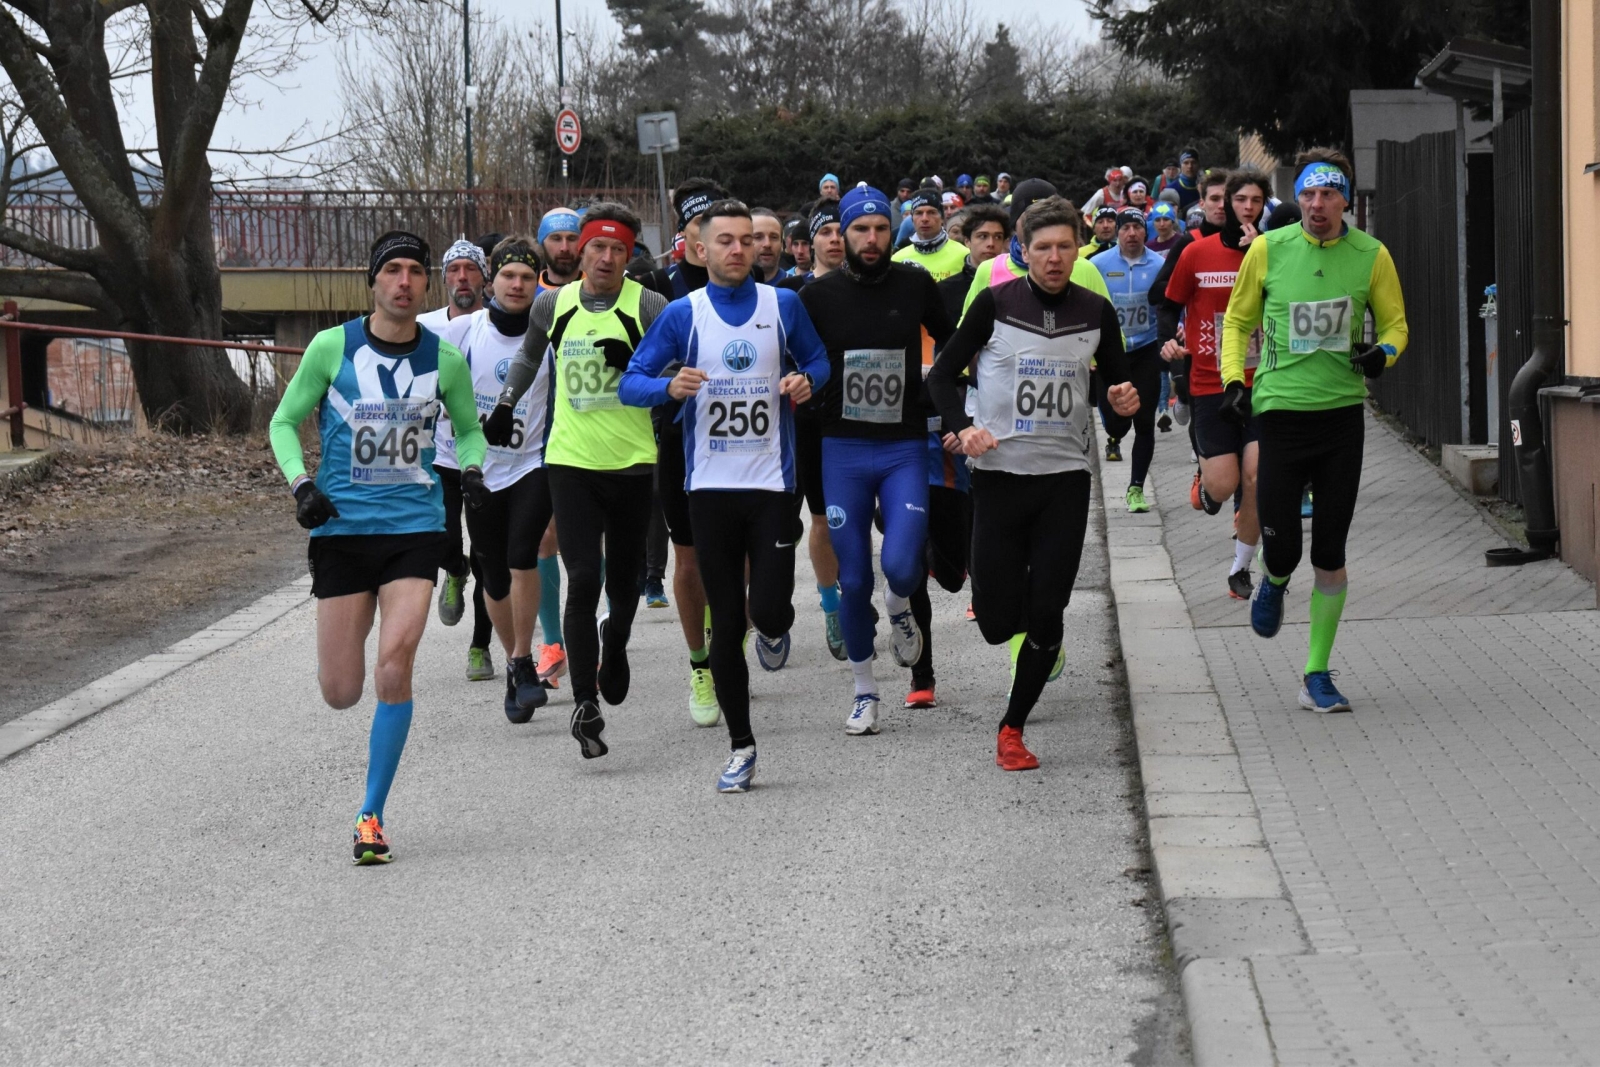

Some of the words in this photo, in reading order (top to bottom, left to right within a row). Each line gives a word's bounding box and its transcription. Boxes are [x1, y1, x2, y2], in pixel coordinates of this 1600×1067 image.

[1303, 172, 1346, 188] eleven
[1115, 305, 1148, 327] 676
[1293, 300, 1348, 337] 657
[564, 338, 586, 348] ZIMNÍ
[562, 347, 598, 357] BĚŽECKÁ
[884, 361, 903, 369] LIGA
[1019, 357, 1046, 367] ZIMNÍ
[1018, 366, 1056, 377] BĚŽECKÁ
[1059, 369, 1076, 378] LIGA
[564, 360, 621, 396] 632
[707, 376, 734, 387] ZIMNÍ
[707, 386, 747, 396] BĚŽECKÁ
[750, 385, 770, 395] LIGA
[846, 371, 903, 407] 669
[474, 392, 497, 403] ZIMNÍ
[1016, 379, 1074, 418] 640
[354, 401, 385, 412] ZIMNÍ
[354, 411, 398, 421] BĚŽECKÁ
[401, 413, 423, 421] LIGA
[708, 399, 770, 438] 256
[354, 425, 420, 466] 646
